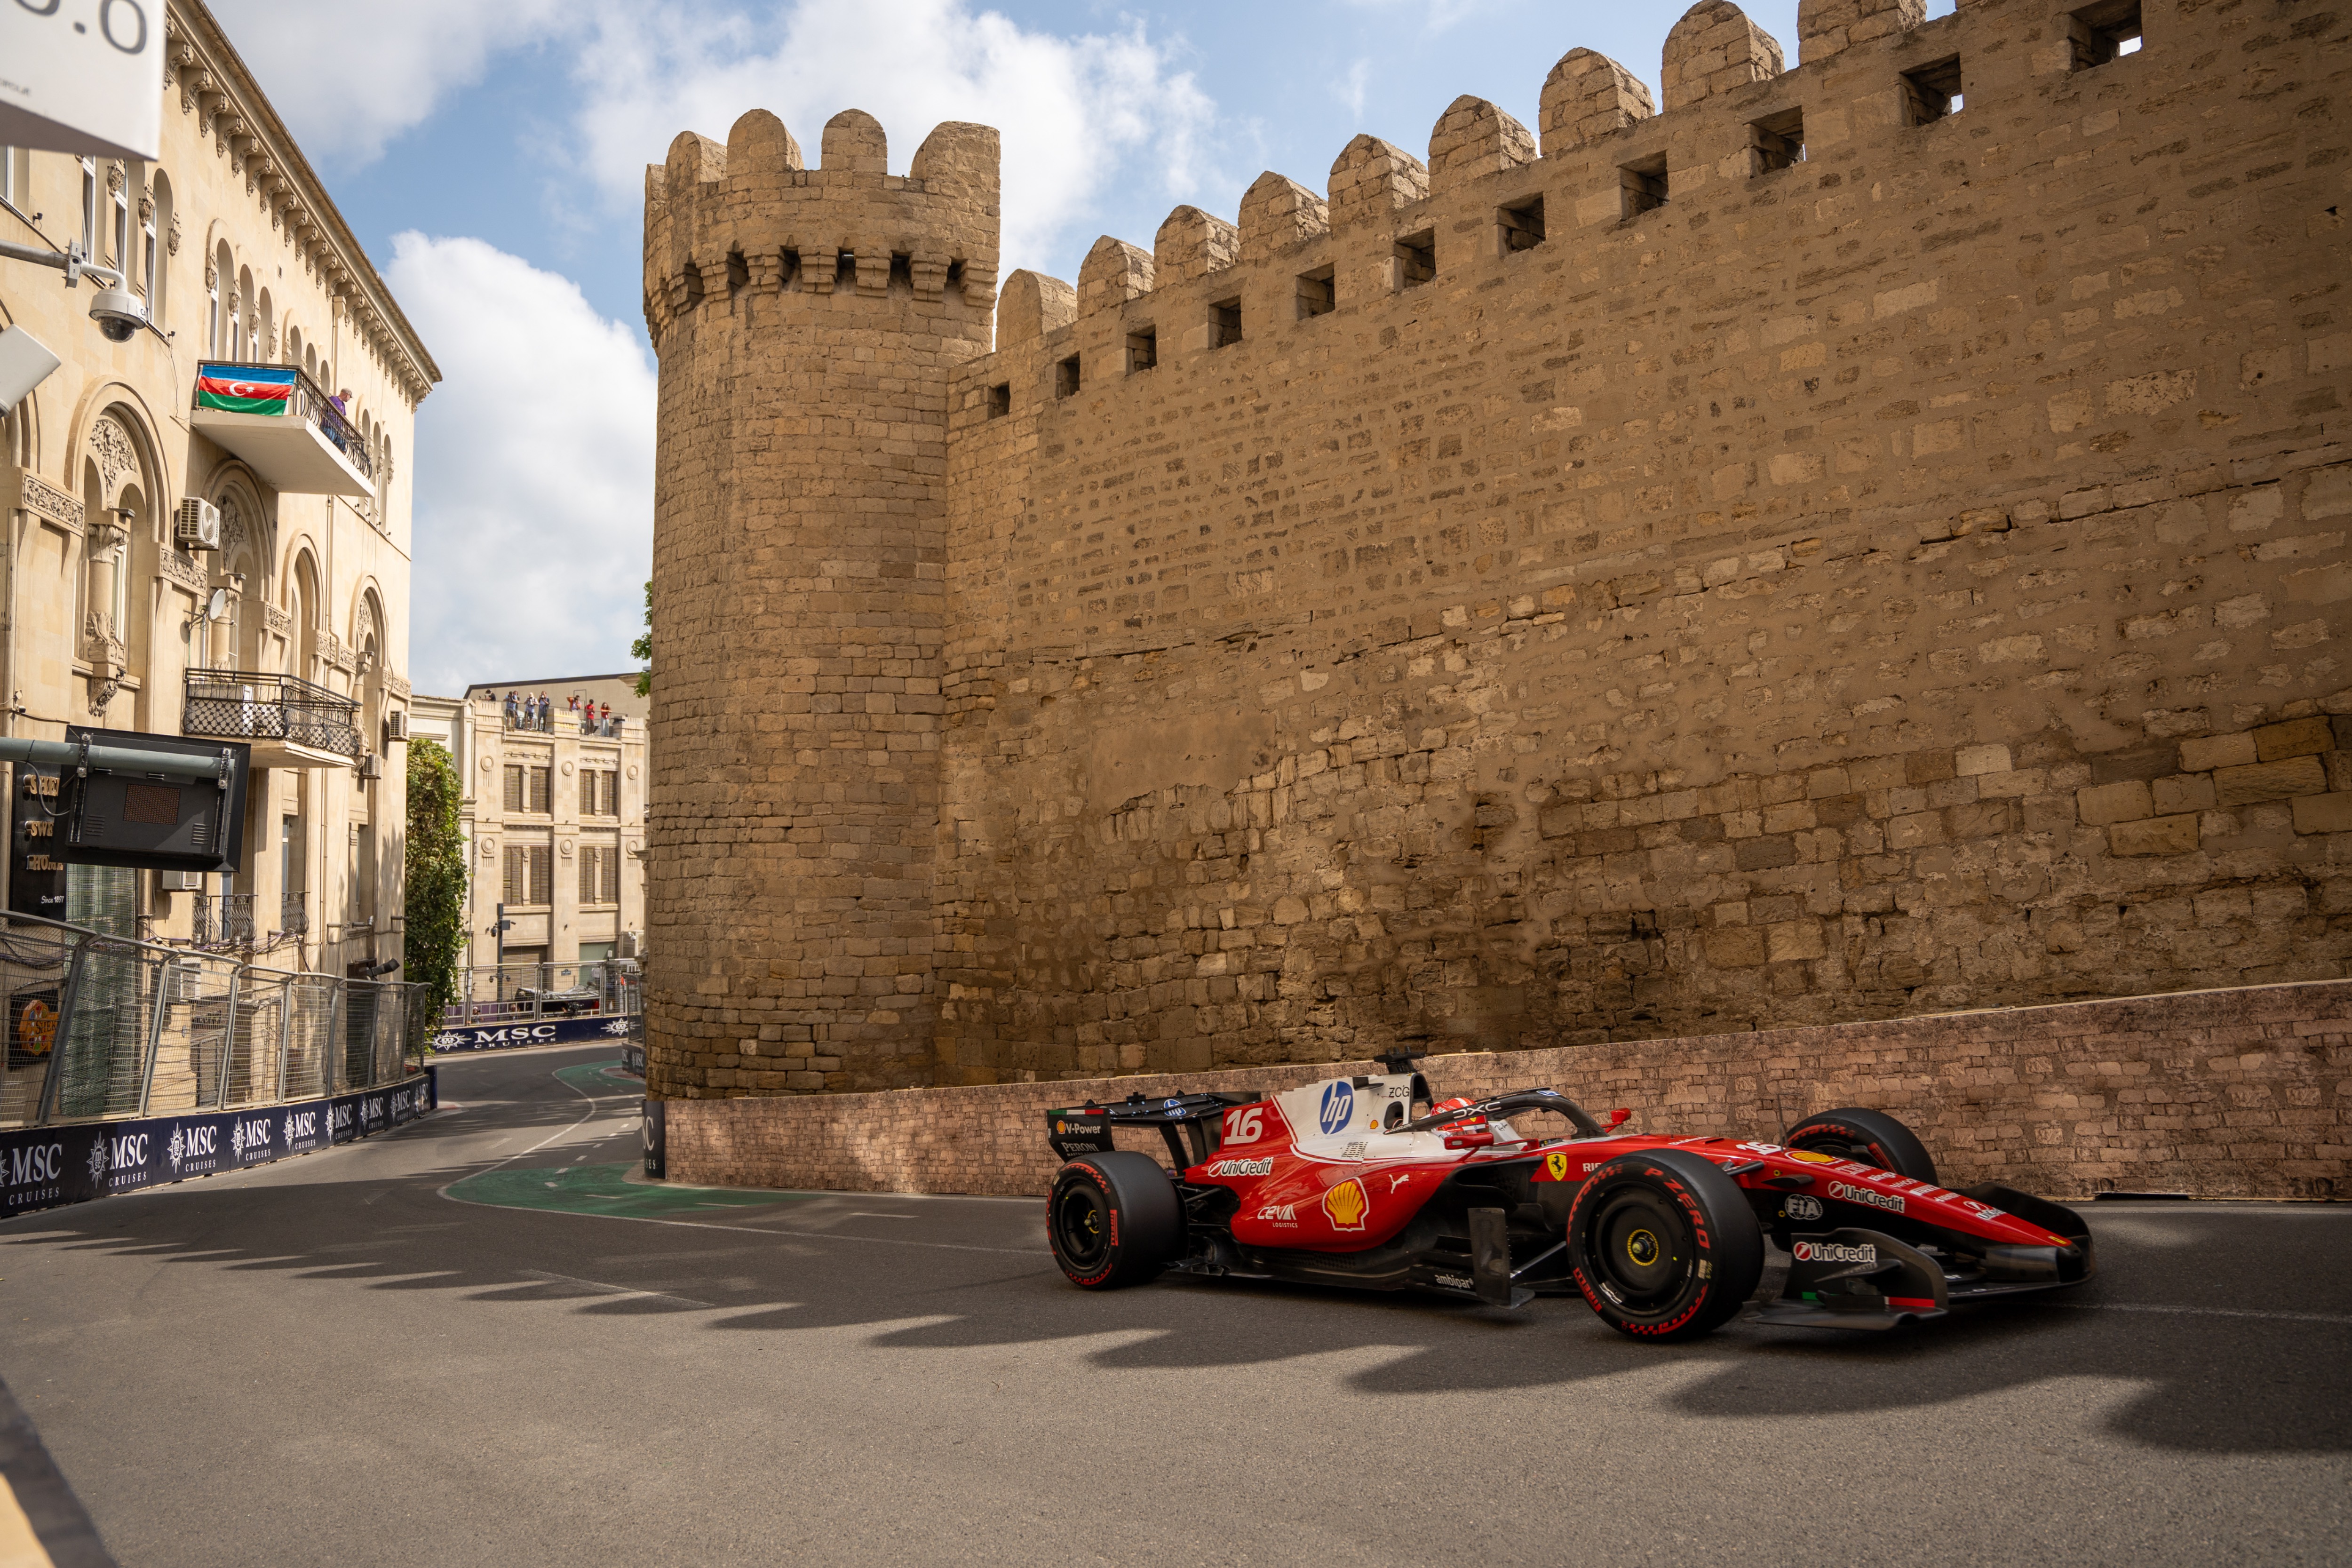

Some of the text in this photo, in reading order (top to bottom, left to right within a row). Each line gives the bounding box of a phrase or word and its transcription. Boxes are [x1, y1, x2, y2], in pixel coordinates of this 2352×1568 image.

[474, 1026, 556, 1043] MSC
[474, 1037, 556, 1049] CRUISES
[369, 1097, 383, 1119] MSC
[397, 1090, 410, 1111] MSC
[1322, 1082, 1351, 1134] hp
[335, 1104, 352, 1129] MSC
[1453, 1101, 1502, 1119] DXC
[246, 1118, 271, 1147] MSC
[295, 1112, 316, 1138] MSC
[369, 1120, 383, 1129] CRUISES
[1065, 1123, 1101, 1134] V-Power
[1224, 1107, 1263, 1145] 16
[186, 1125, 217, 1157] MSC
[335, 1129, 352, 1139] CRUISES
[109, 1133, 148, 1170] MSC
[295, 1139, 316, 1150] CRUISES
[1061, 1142, 1100, 1152] PERONI
[1735, 1141, 1782, 1155] 16
[246, 1149, 271, 1161] CRUISES
[10, 1143, 62, 1186] MSC
[185, 1159, 216, 1172] CRUISES
[1222, 1159, 1272, 1174] UniCredit
[109, 1171, 147, 1187] CRUISES
[9, 1187, 59, 1205] CRUISES
[1845, 1185, 1904, 1212] UniCredit
[1663, 1178, 1710, 1250] ZERO
[1110, 1210, 1119, 1246] PIRELLI
[1812, 1244, 1874, 1261] UniCredit
[1435, 1274, 1471, 1289] ambipar
[1573, 1267, 1602, 1313] PIRELLI
